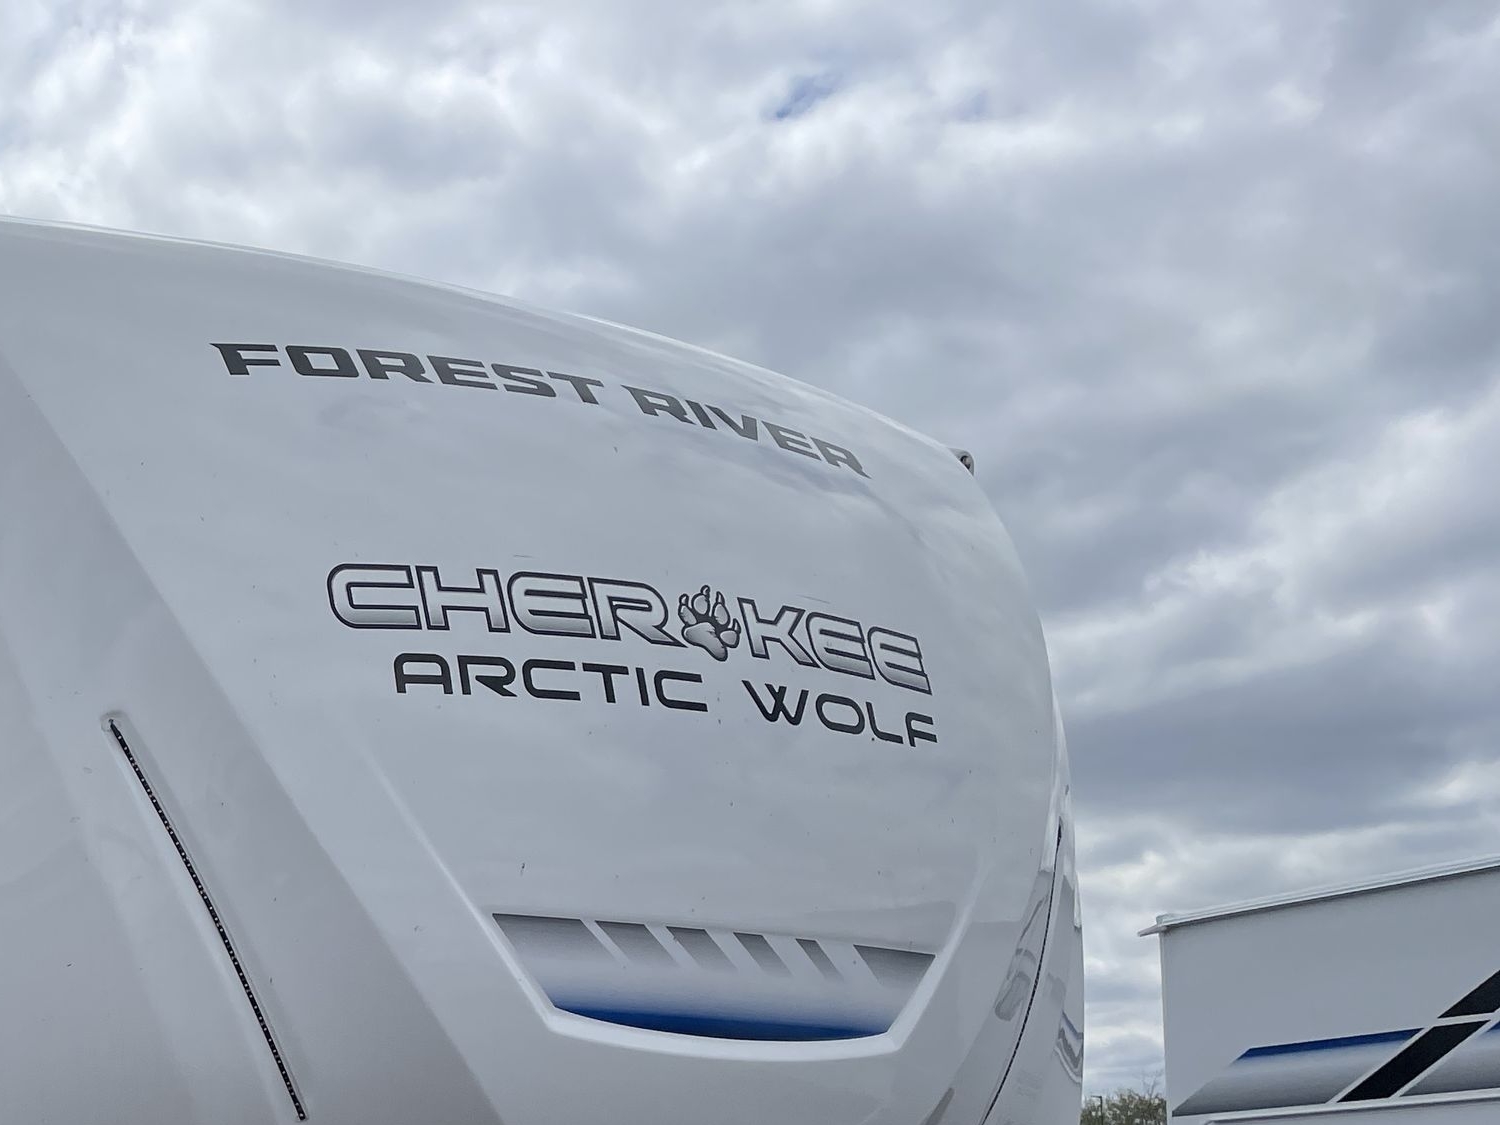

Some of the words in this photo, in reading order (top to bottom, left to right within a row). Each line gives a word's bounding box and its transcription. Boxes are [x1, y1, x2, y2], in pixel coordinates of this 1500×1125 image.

[210, 342, 604, 406] FOREST
[620, 383, 872, 478] RIVER
[393, 652, 708, 712] ARCTIC
[741, 679, 938, 747] WOLF
